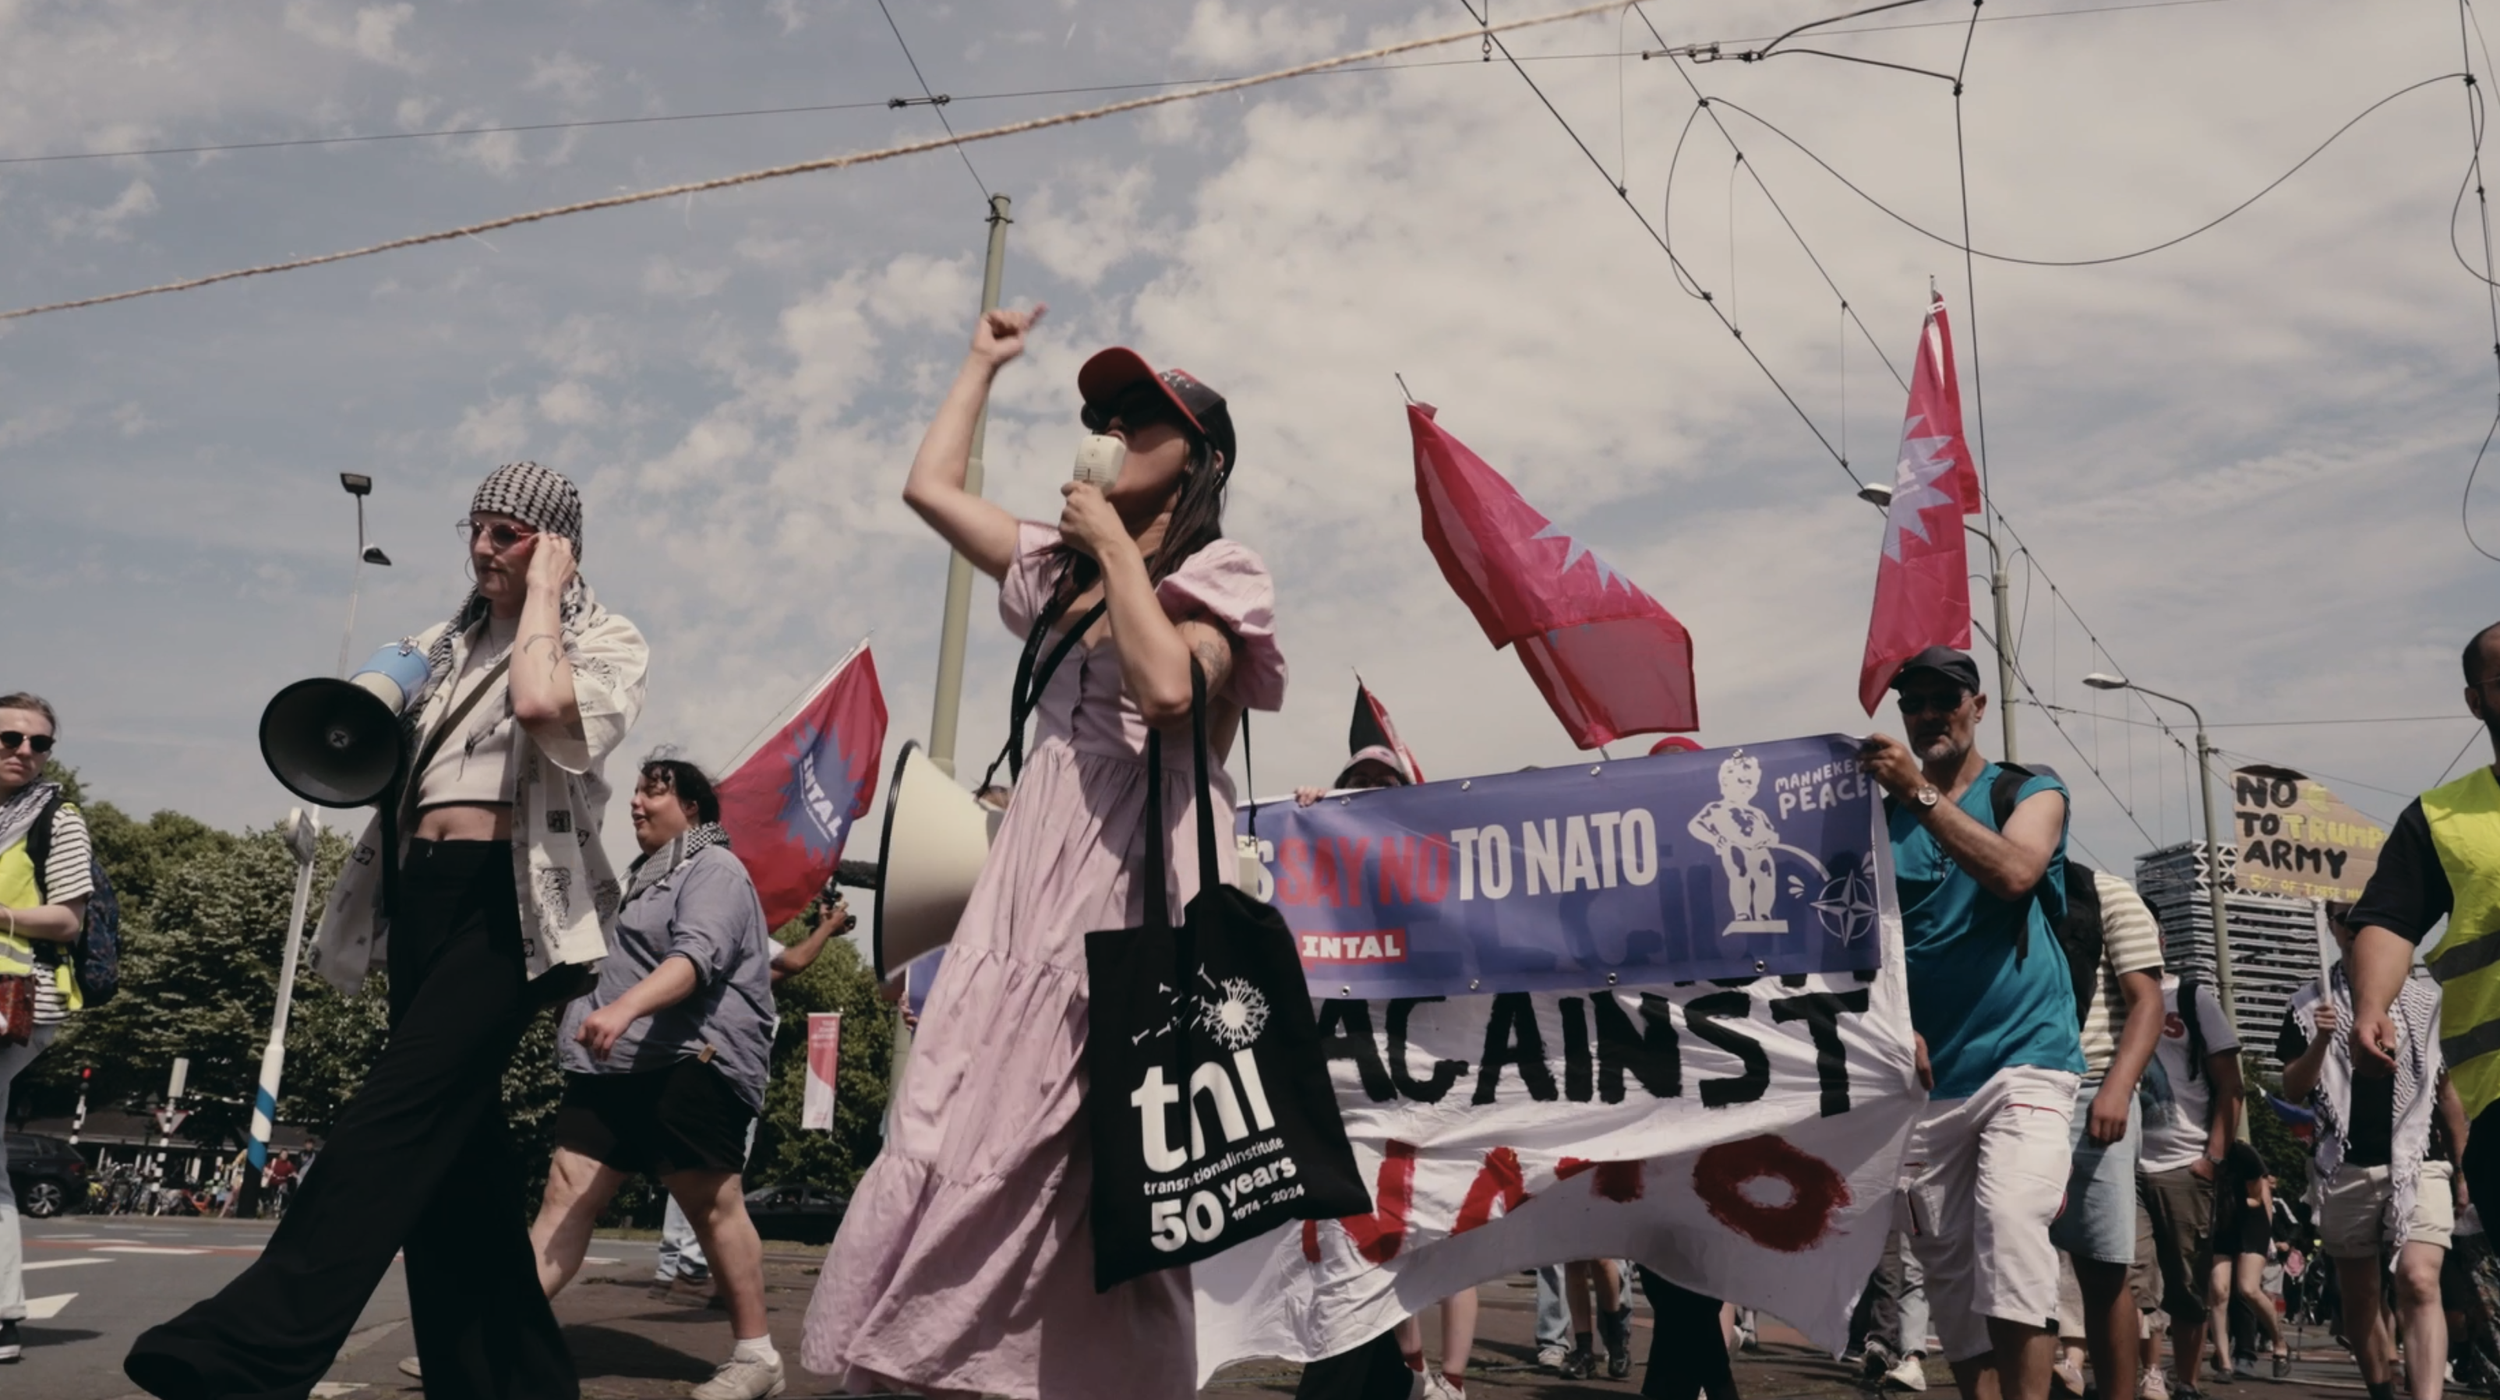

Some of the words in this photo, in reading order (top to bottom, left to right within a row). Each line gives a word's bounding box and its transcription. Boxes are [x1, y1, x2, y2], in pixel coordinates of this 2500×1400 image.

[1779, 772, 1868, 820] PEACE
[2236, 775, 2298, 808] NO
[2235, 811, 2280, 838] TO
[1276, 835, 1371, 908] SAY
[1378, 831, 1449, 906] NO
[1451, 822, 1512, 901] TO
[1523, 808, 1658, 896] NATO
[2243, 839, 2347, 879] ARMY
[1302, 934, 1401, 959] INTAL
[1151, 1189, 1225, 1252] 50
[1220, 1156, 1297, 1208] years
[1231, 1201, 1261, 1221] 1974
[1270, 1183, 1305, 1203] 2024
